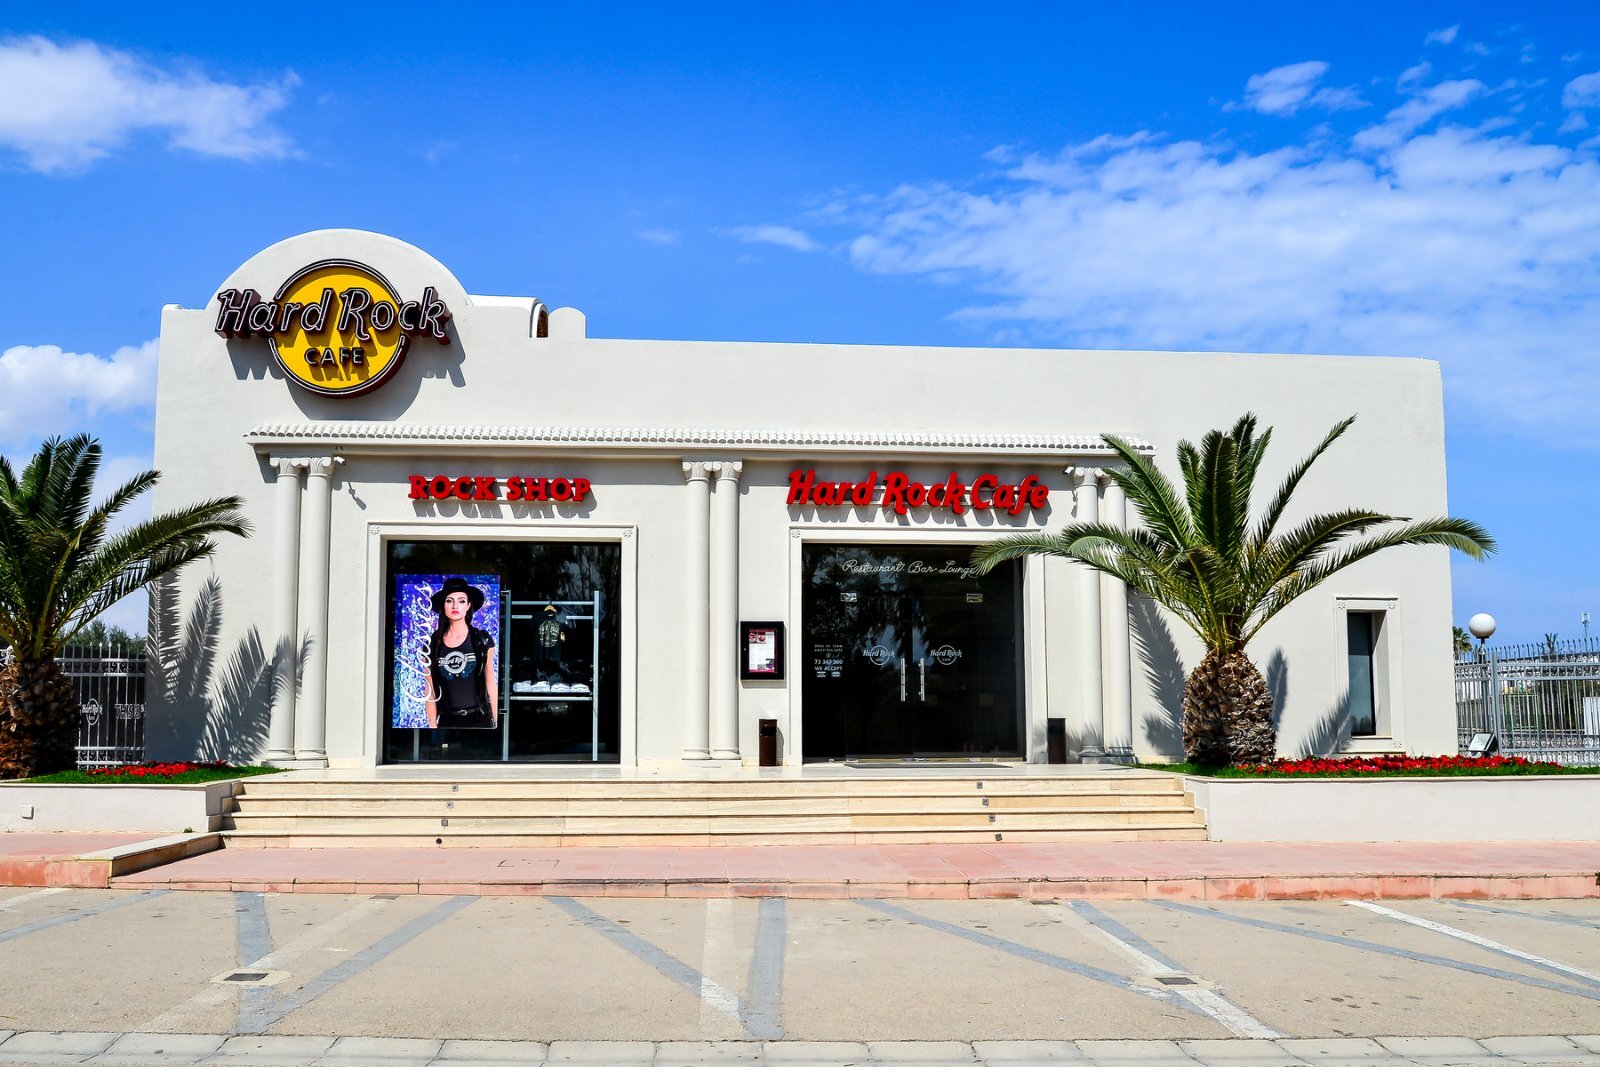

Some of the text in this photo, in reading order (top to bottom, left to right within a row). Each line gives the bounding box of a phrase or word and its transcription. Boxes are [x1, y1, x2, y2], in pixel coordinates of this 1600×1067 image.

[215, 286, 446, 341] Hard Rock
[304, 347, 364, 366] CAFE
[408, 475, 591, 501] ROCK SHOP
[786, 469, 1049, 515] Hard Rock Cafe
[397, 581, 442, 702] Classics
[863, 649, 896, 658] Hard Rock
[930, 649, 963, 658] Hard Rock
